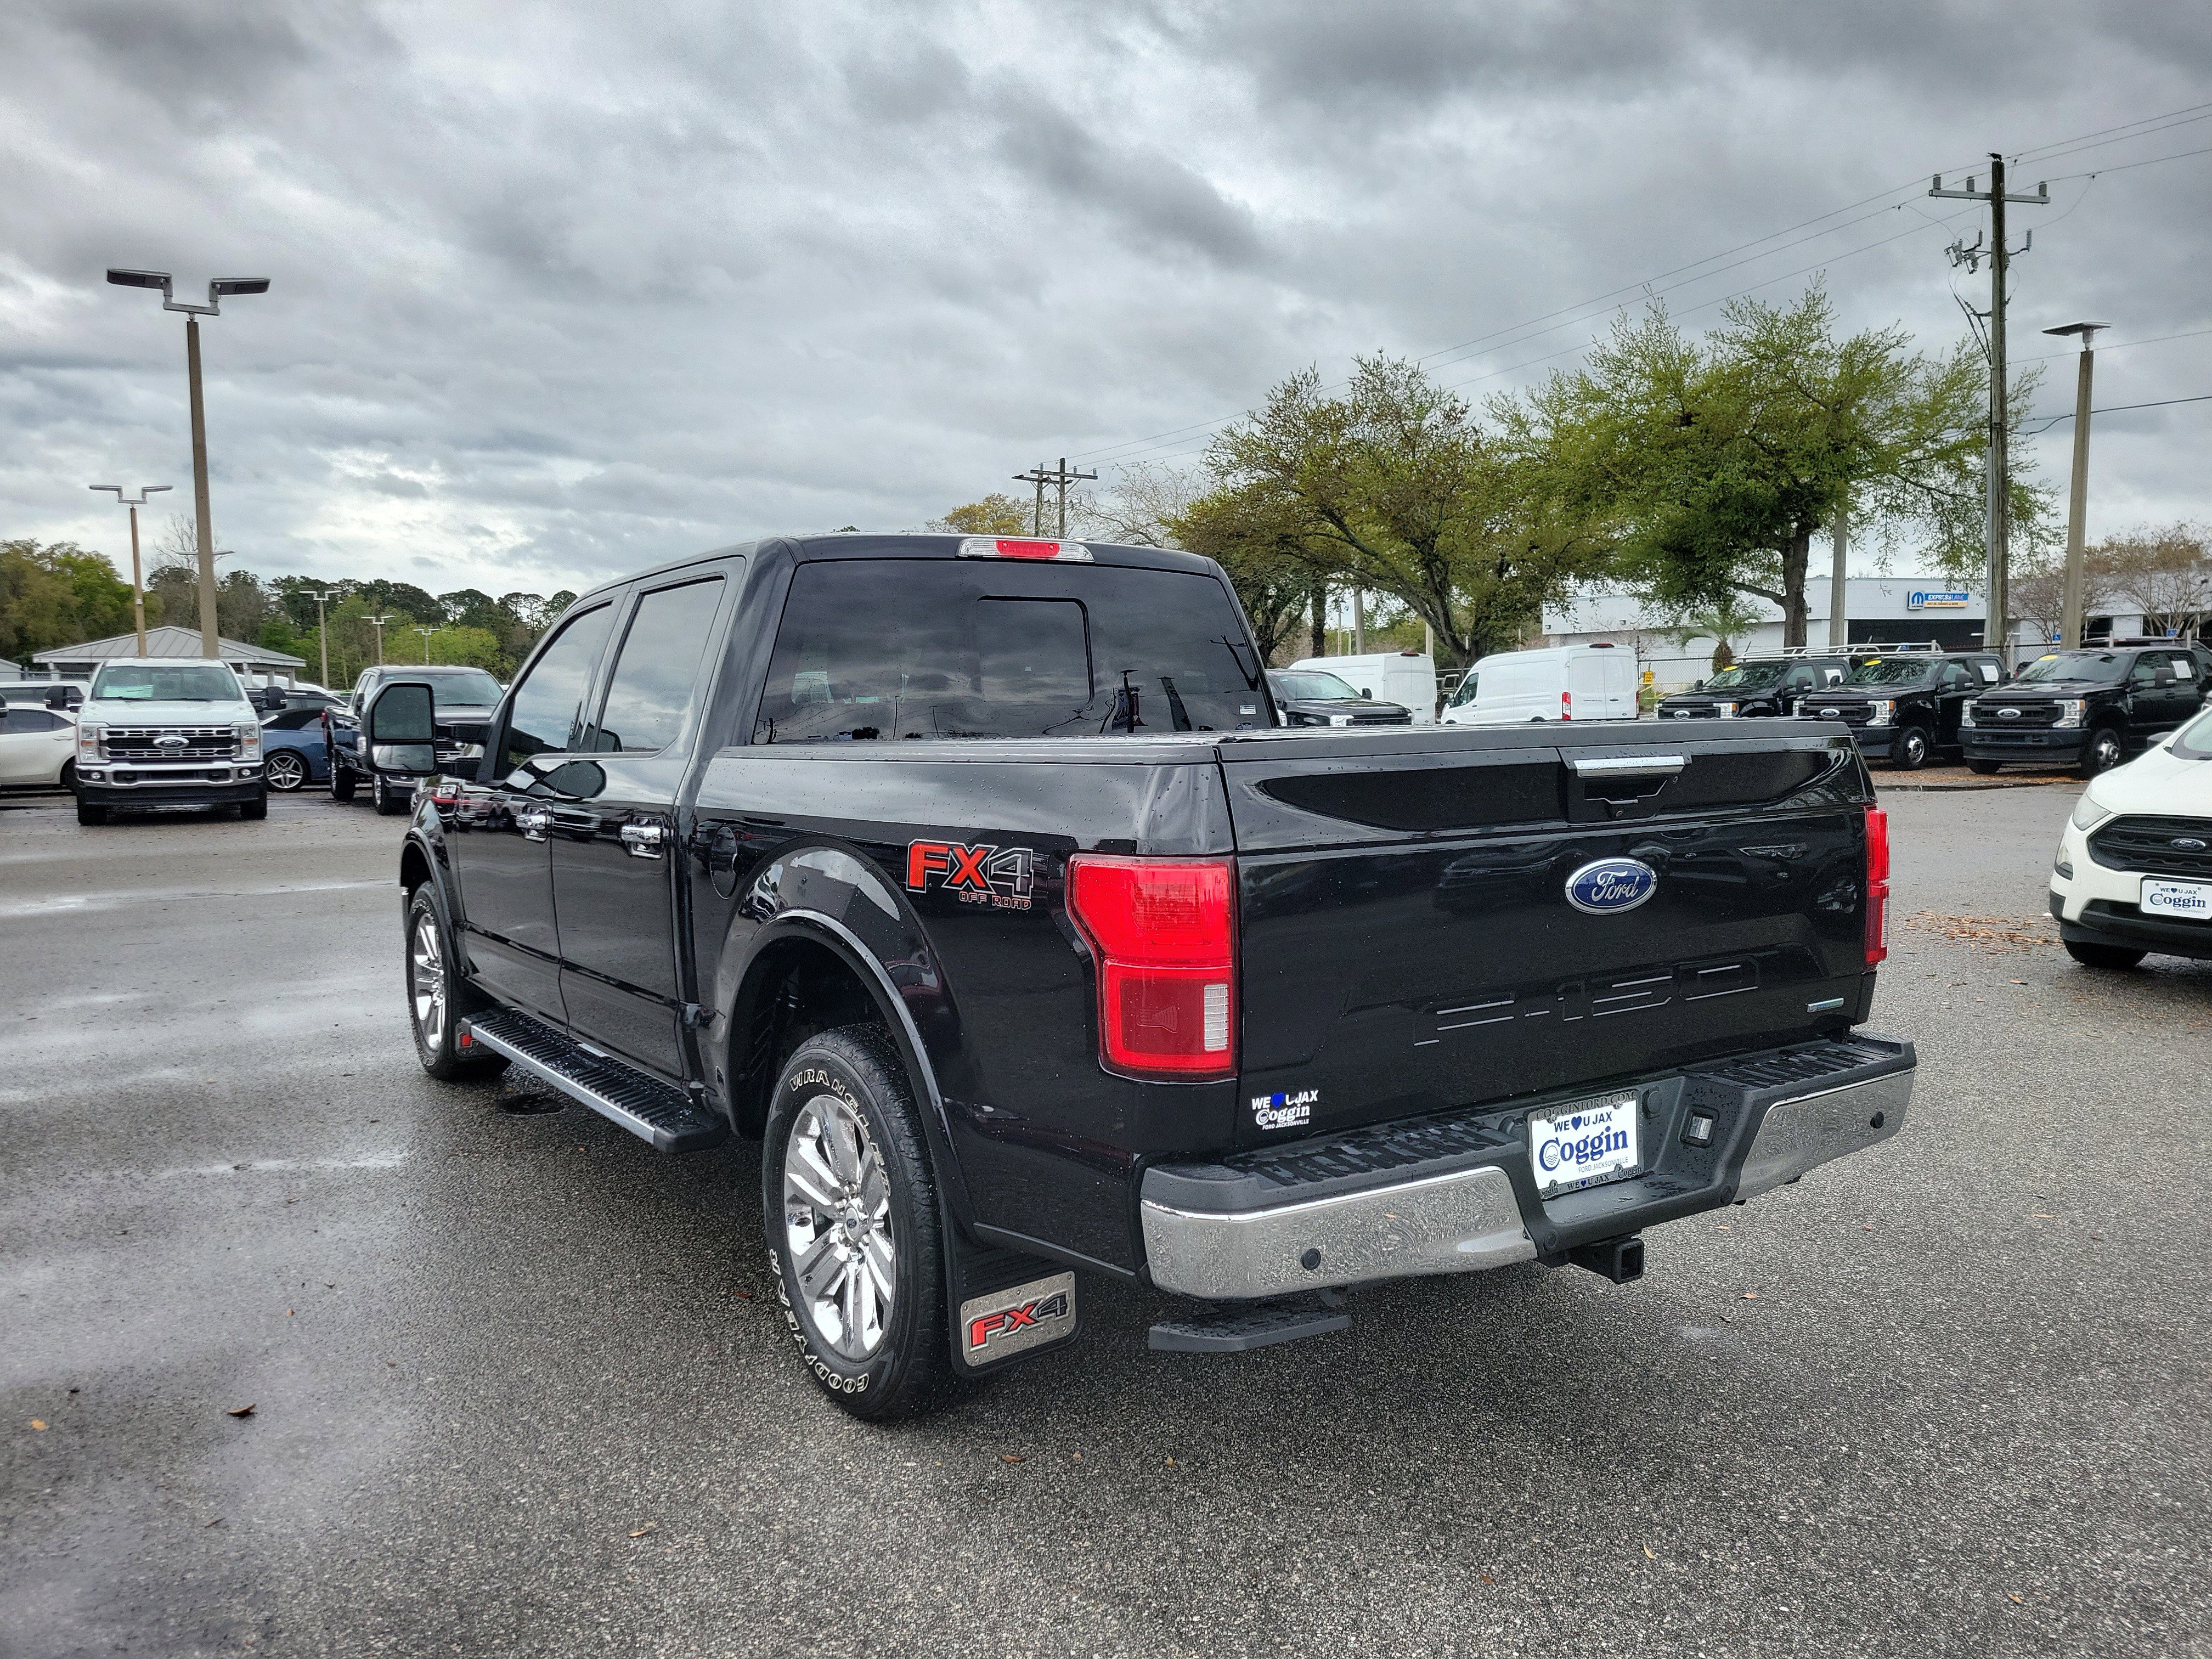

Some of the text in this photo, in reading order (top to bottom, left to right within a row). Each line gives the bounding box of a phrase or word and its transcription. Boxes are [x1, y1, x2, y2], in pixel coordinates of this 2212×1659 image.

[2177, 840, 2197, 848] Ford
[906, 838, 1034, 899] FX4
[1591, 871, 1640, 902] Ford
[959, 891, 1031, 911] OFF ROAD
[2149, 893, 2207, 909] Coggin
[1251, 1096, 1271, 1110] WE
[1295, 1090, 1318, 1104] JAX
[1536, 1091, 1636, 1120] COGGINFORD.COM
[1255, 1103, 1310, 1126] Coggin
[1276, 1118, 1310, 1128] JACKSONVILLE
[1554, 1111, 1612, 1133] WE U JAX
[789, 1069, 891, 1197] WRANGLER
[1539, 1125, 1628, 1172] Coggin
[1578, 1156, 1629, 1174] FORD JACKSONVILLE
[1539, 1185, 1559, 1199] oggin
[1567, 1181, 1580, 1191] WE
[1587, 1177, 1594, 1186] U
[1594, 1174, 1610, 1184] JAX
[770, 1248, 870, 1393] GOODYEAR
[969, 1291, 1069, 1350] FX4
